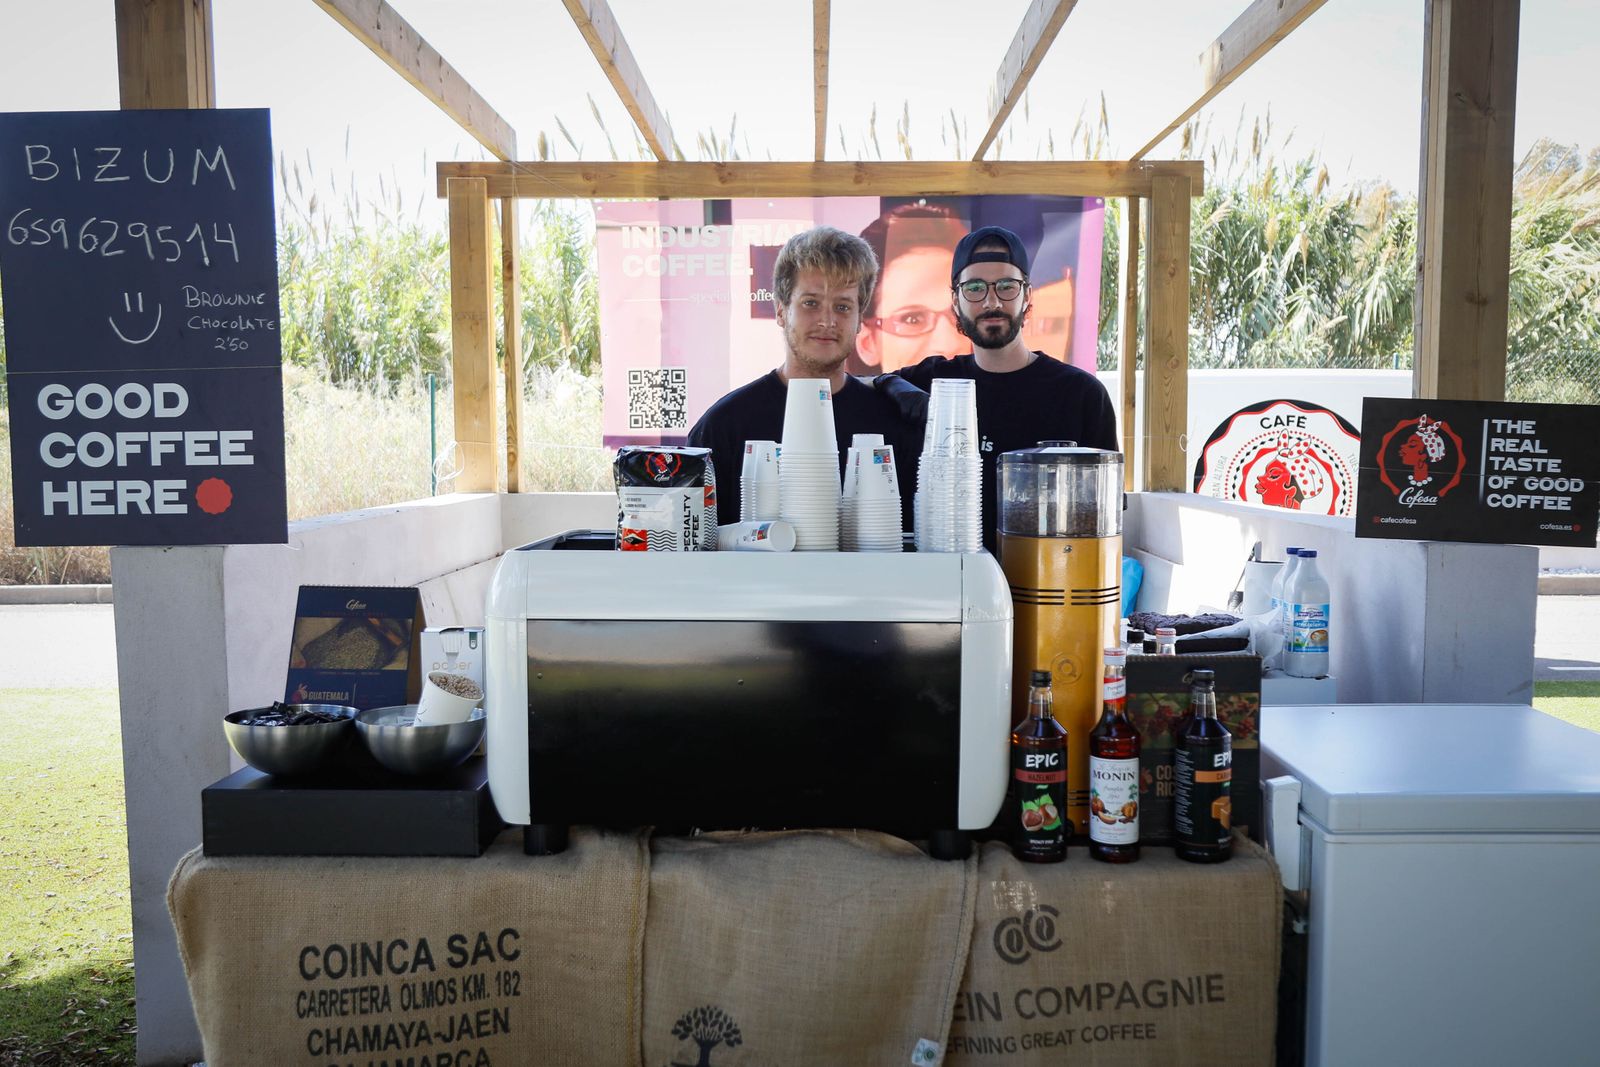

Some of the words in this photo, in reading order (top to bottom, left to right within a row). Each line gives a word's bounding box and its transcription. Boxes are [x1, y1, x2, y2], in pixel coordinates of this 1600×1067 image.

[25, 144, 236, 190] BIZUM
[622, 224, 810, 249] INDUSTRIA
[182, 285, 266, 308] BROWNIE
[187, 314, 275, 331] CHOCOLATE
[37, 382, 189, 420] GOOD
[1491, 419, 1537, 435] THE
[39, 430, 255, 468] COFFEE
[1489, 437, 1548, 454] REAL
[1488, 456, 1562, 473] TASTE
[1487, 475, 1517, 490] OF
[1524, 477, 1585, 493] GOOD
[42, 479, 189, 516] HERE
[1398, 486, 1439, 509] Cofesa
[1486, 493, 1572, 511] COFFEE
[683, 494, 692, 552] PECIALTY
[692, 514, 700, 552] OFFEE
[1539, 523, 1573, 532] cofesa.es
[308, 691, 350, 701] GUATEMALA
[1025, 753, 1059, 769] EPIC
[1213, 751, 1232, 768] EPI
[1093, 771, 1136, 782] MONIN
[298, 938, 437, 981] COINCA
[446, 927, 522, 969] SAC
[296, 983, 392, 1019] CARRETERA
[400, 977, 457, 1012] OLMOS
[462, 972, 491, 1003] KM.
[494, 970, 521, 997] 182
[953, 991, 1003, 1022] EIN
[1014, 973, 1226, 1020] COMPAGNIE
[306, 1006, 511, 1057] CHAMAYA-JAEN
[946, 1035, 1018, 1055] EFINING
[1020, 1028, 1077, 1052] GREAT
[1080, 1022, 1157, 1044] COFFEE
